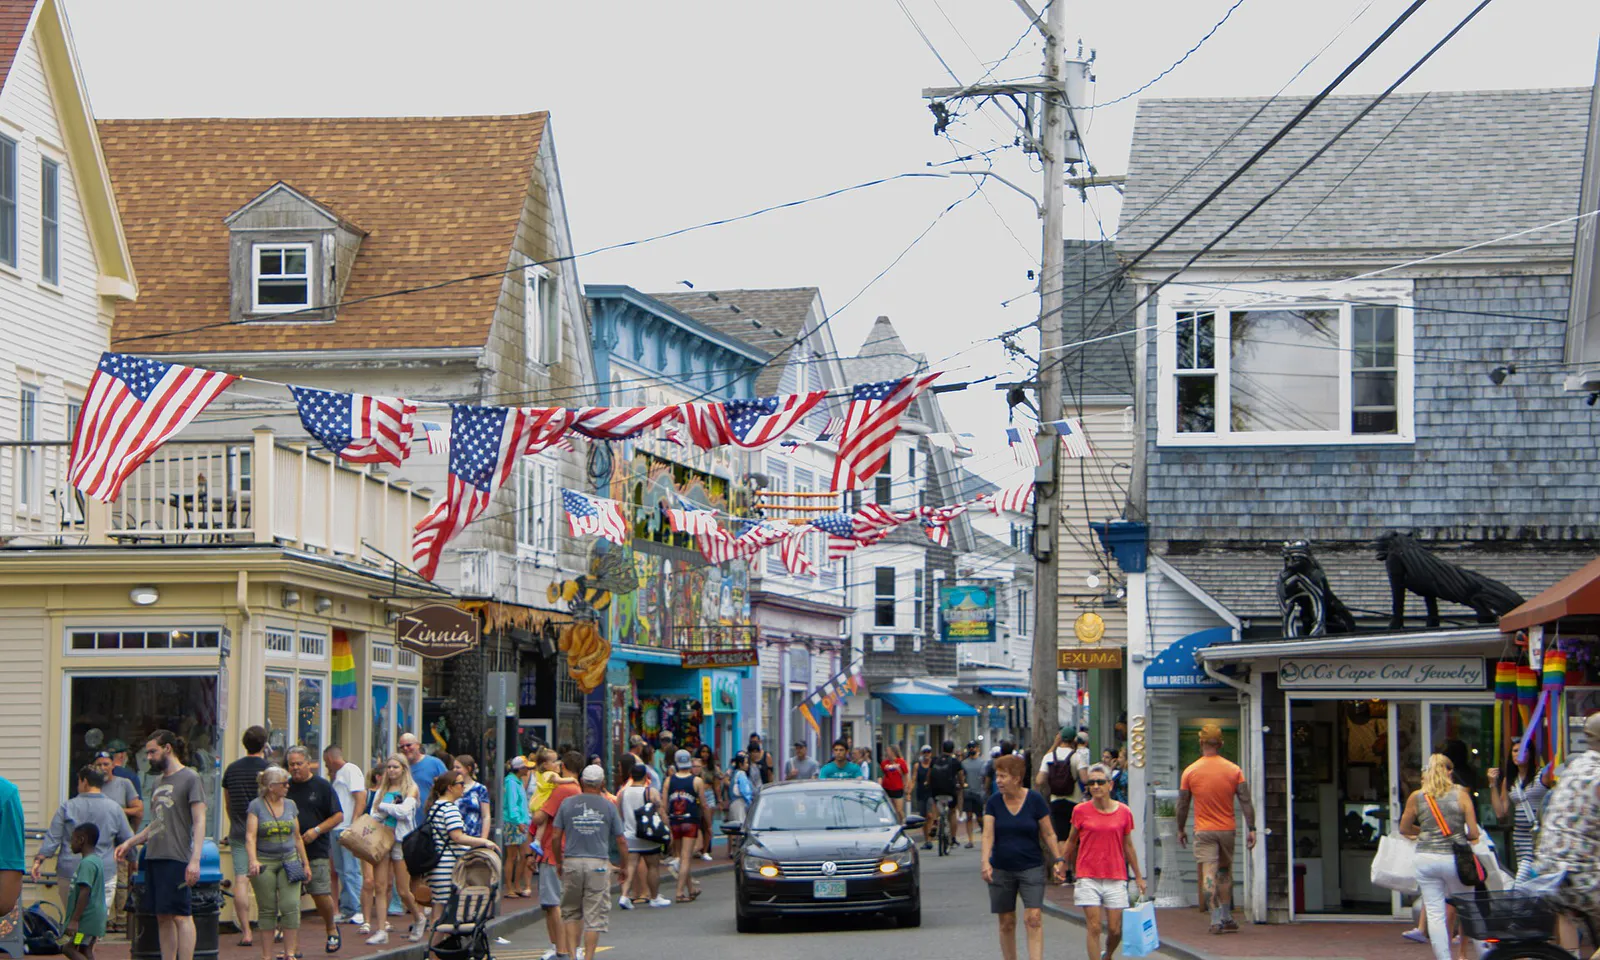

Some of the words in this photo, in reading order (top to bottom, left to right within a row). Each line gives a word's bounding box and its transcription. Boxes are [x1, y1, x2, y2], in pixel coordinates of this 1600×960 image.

[400, 615, 474, 647] Zinnia
[1062, 652, 1117, 664] EXUMA
[1337, 663, 1377, 683] Cape
[1380, 663, 1413, 679] Cod
[1414, 664, 1480, 684] Jewelry
[1130, 714, 1145, 768] 283
